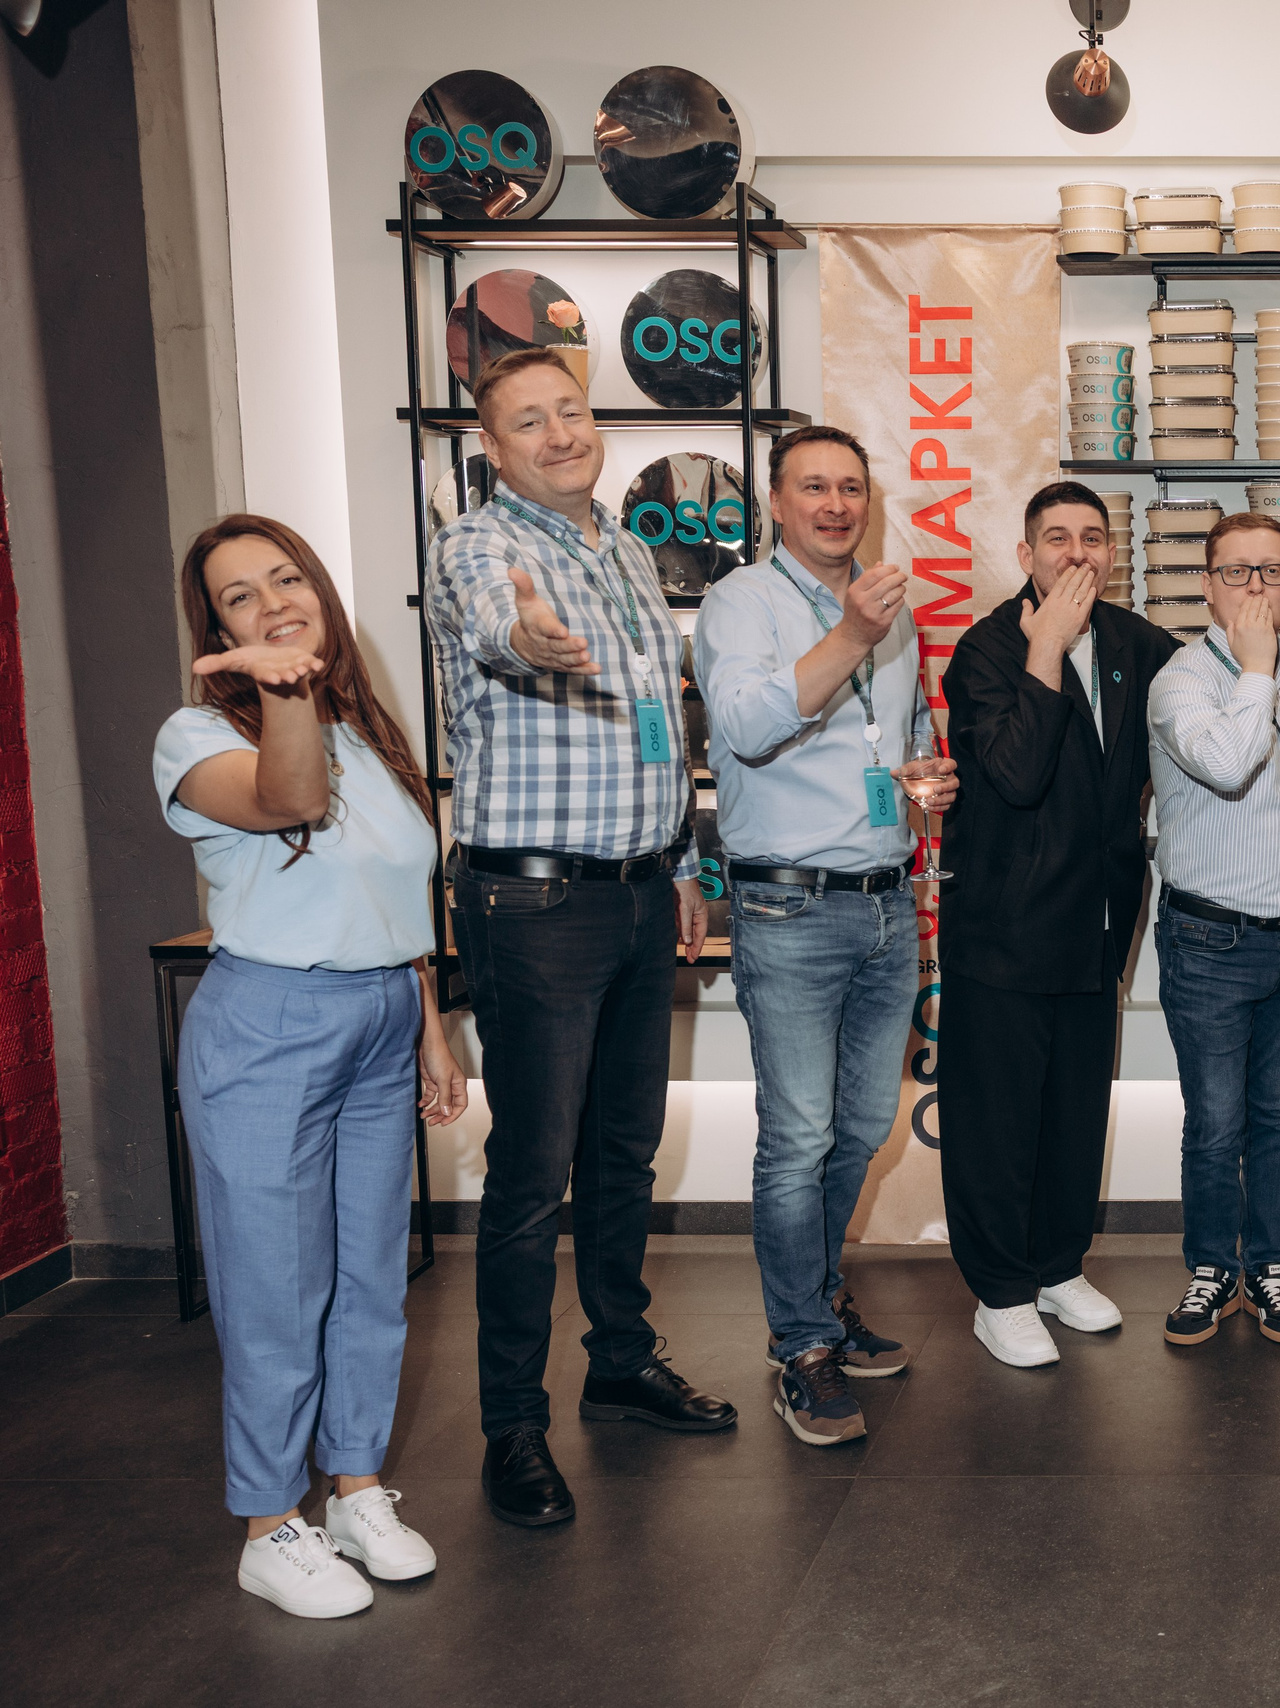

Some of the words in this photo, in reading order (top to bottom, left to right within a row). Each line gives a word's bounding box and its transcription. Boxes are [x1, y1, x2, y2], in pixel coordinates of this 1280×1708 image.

[410, 121, 538, 173] OSQ
[633, 316, 755, 365] OSQ
[1086, 355, 1109, 364] OSQ
[1082, 384, 1104, 393] OSQ
[1082, 413, 1104, 423] OSQ
[1083, 442, 1105, 451] OSQ
[630, 498, 745, 546] OSQ
[649, 722, 660, 751] OSQ
[877, 788, 888, 816] OSQ
